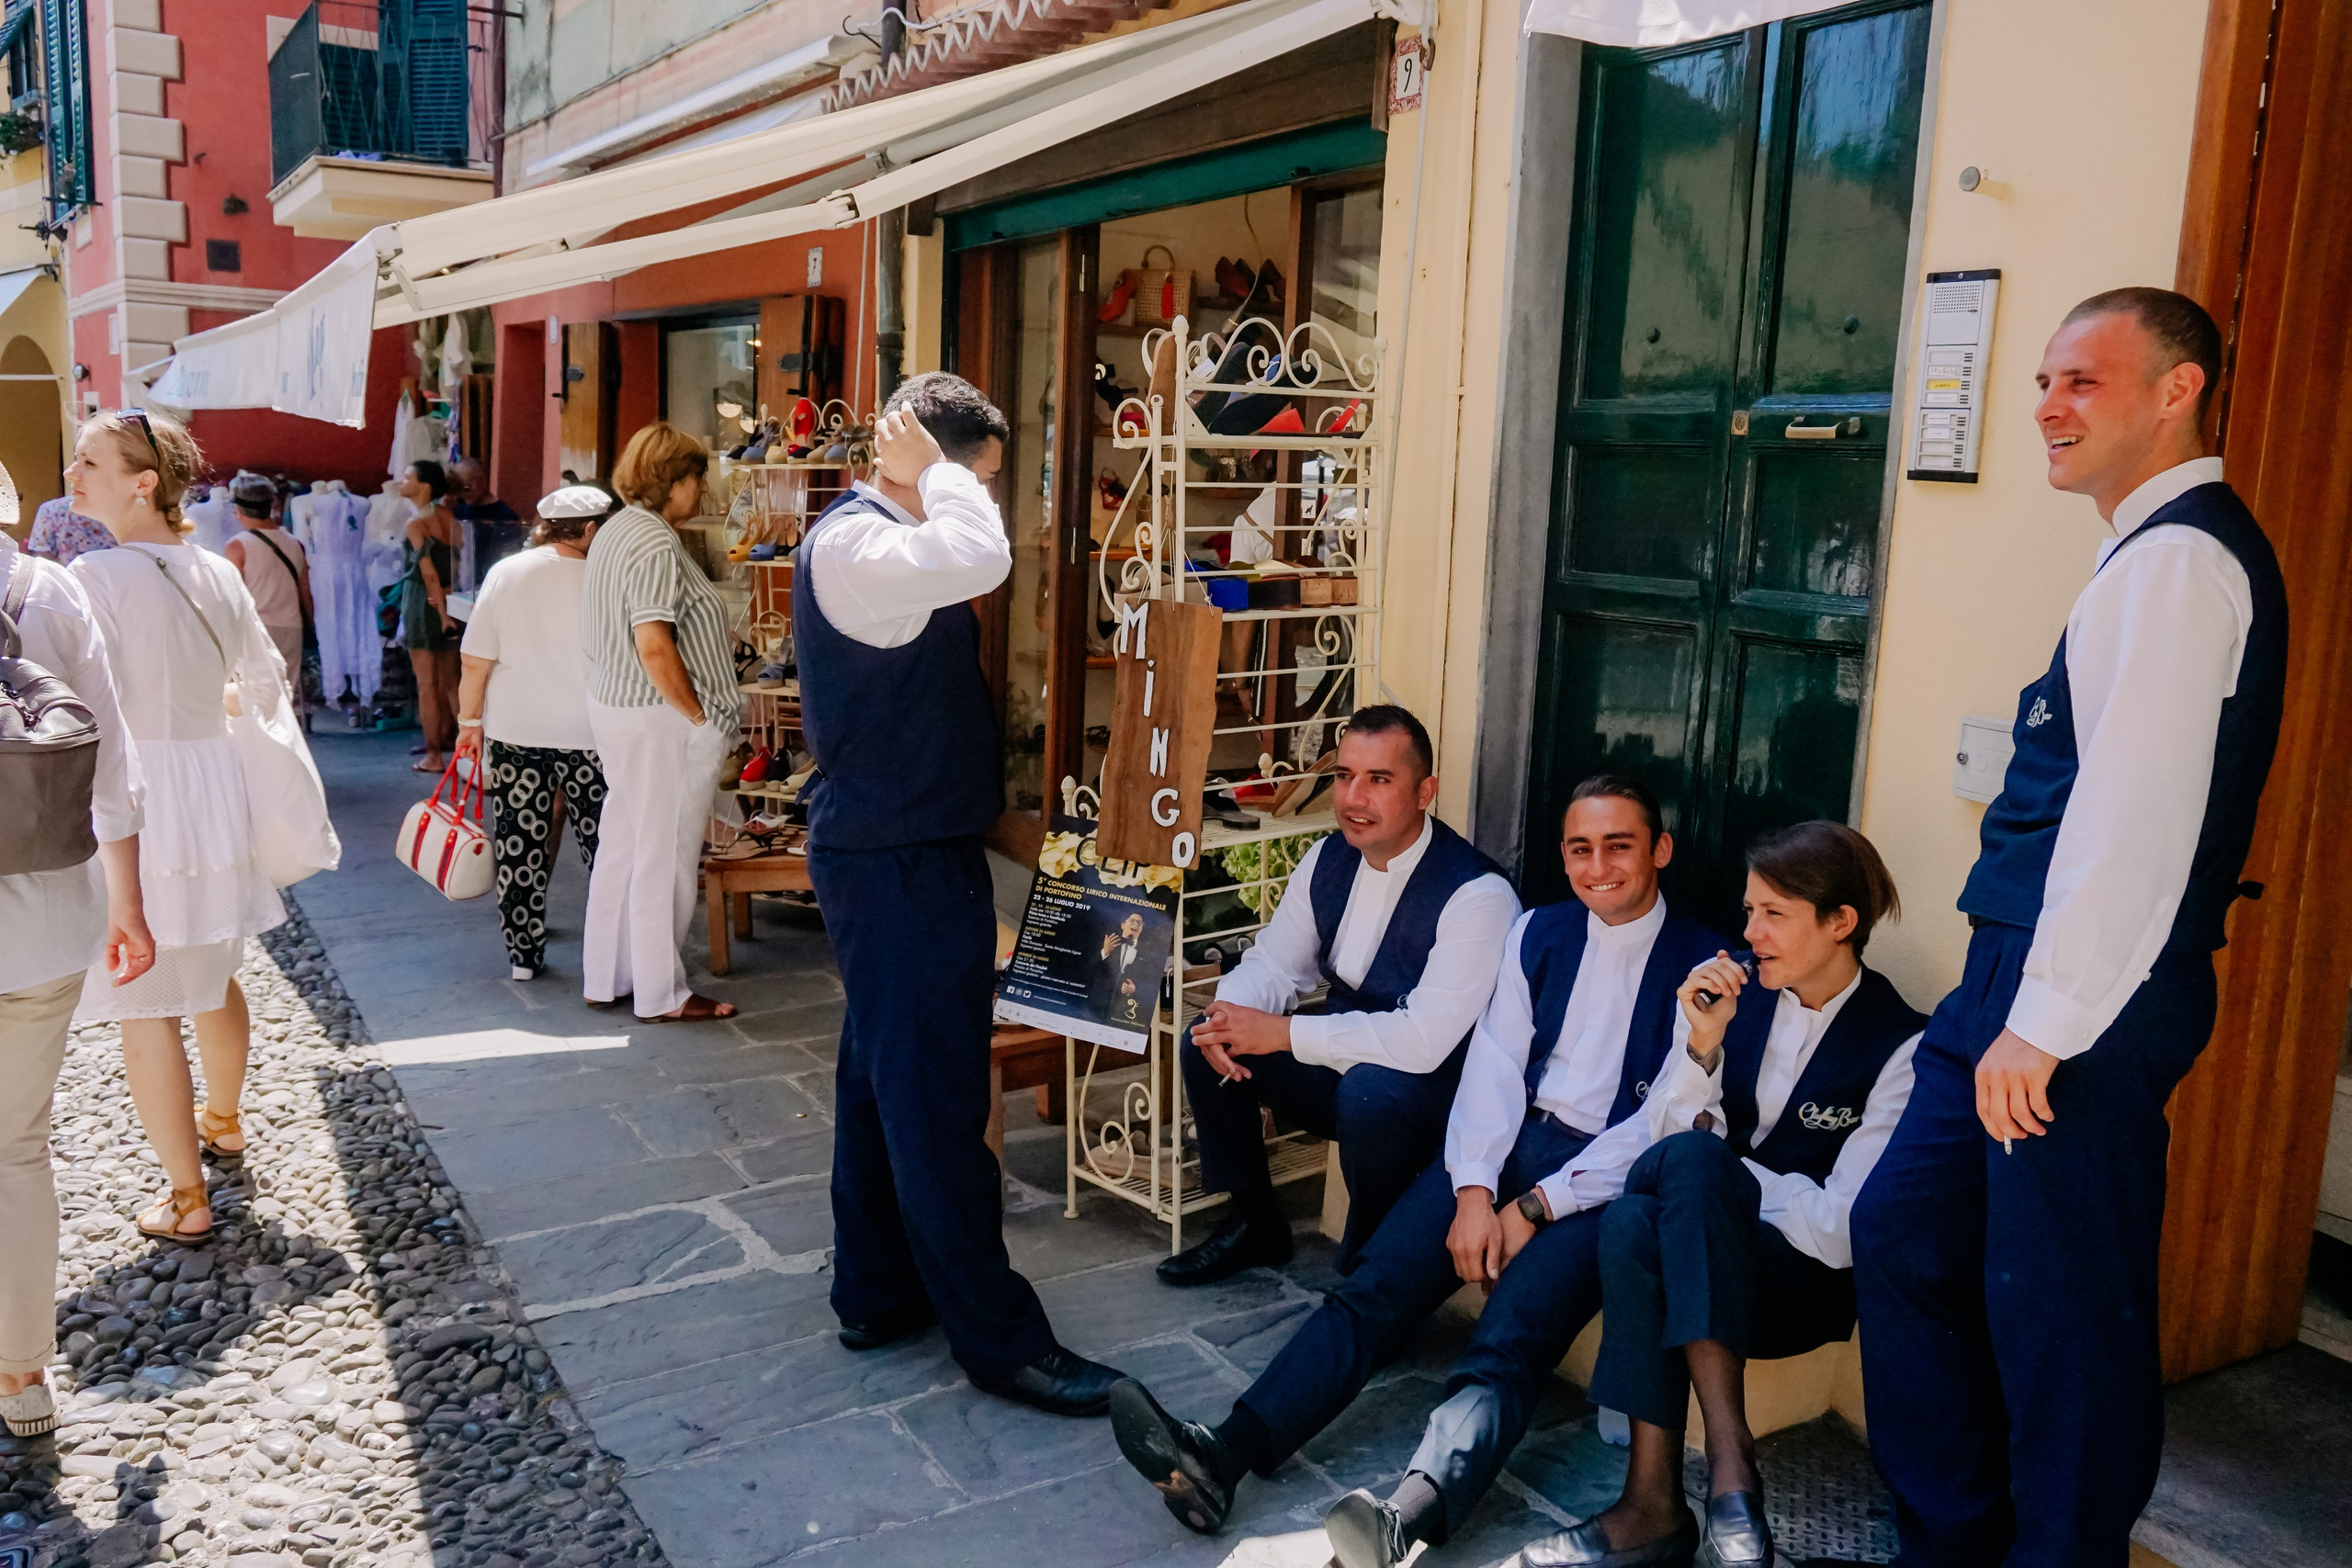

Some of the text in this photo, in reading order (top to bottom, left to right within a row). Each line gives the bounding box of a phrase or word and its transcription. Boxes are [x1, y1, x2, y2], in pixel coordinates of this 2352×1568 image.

[1404, 58, 1413, 93] 9
[1044, 887, 1082, 900] PORTOFINO
[1047, 880, 1085, 892] CONCORSO
[1086, 888, 1108, 898] LIRICO
[1109, 893, 1166, 911] INTERNAZIONALE
[1054, 898, 1074, 907] LUGLIO
